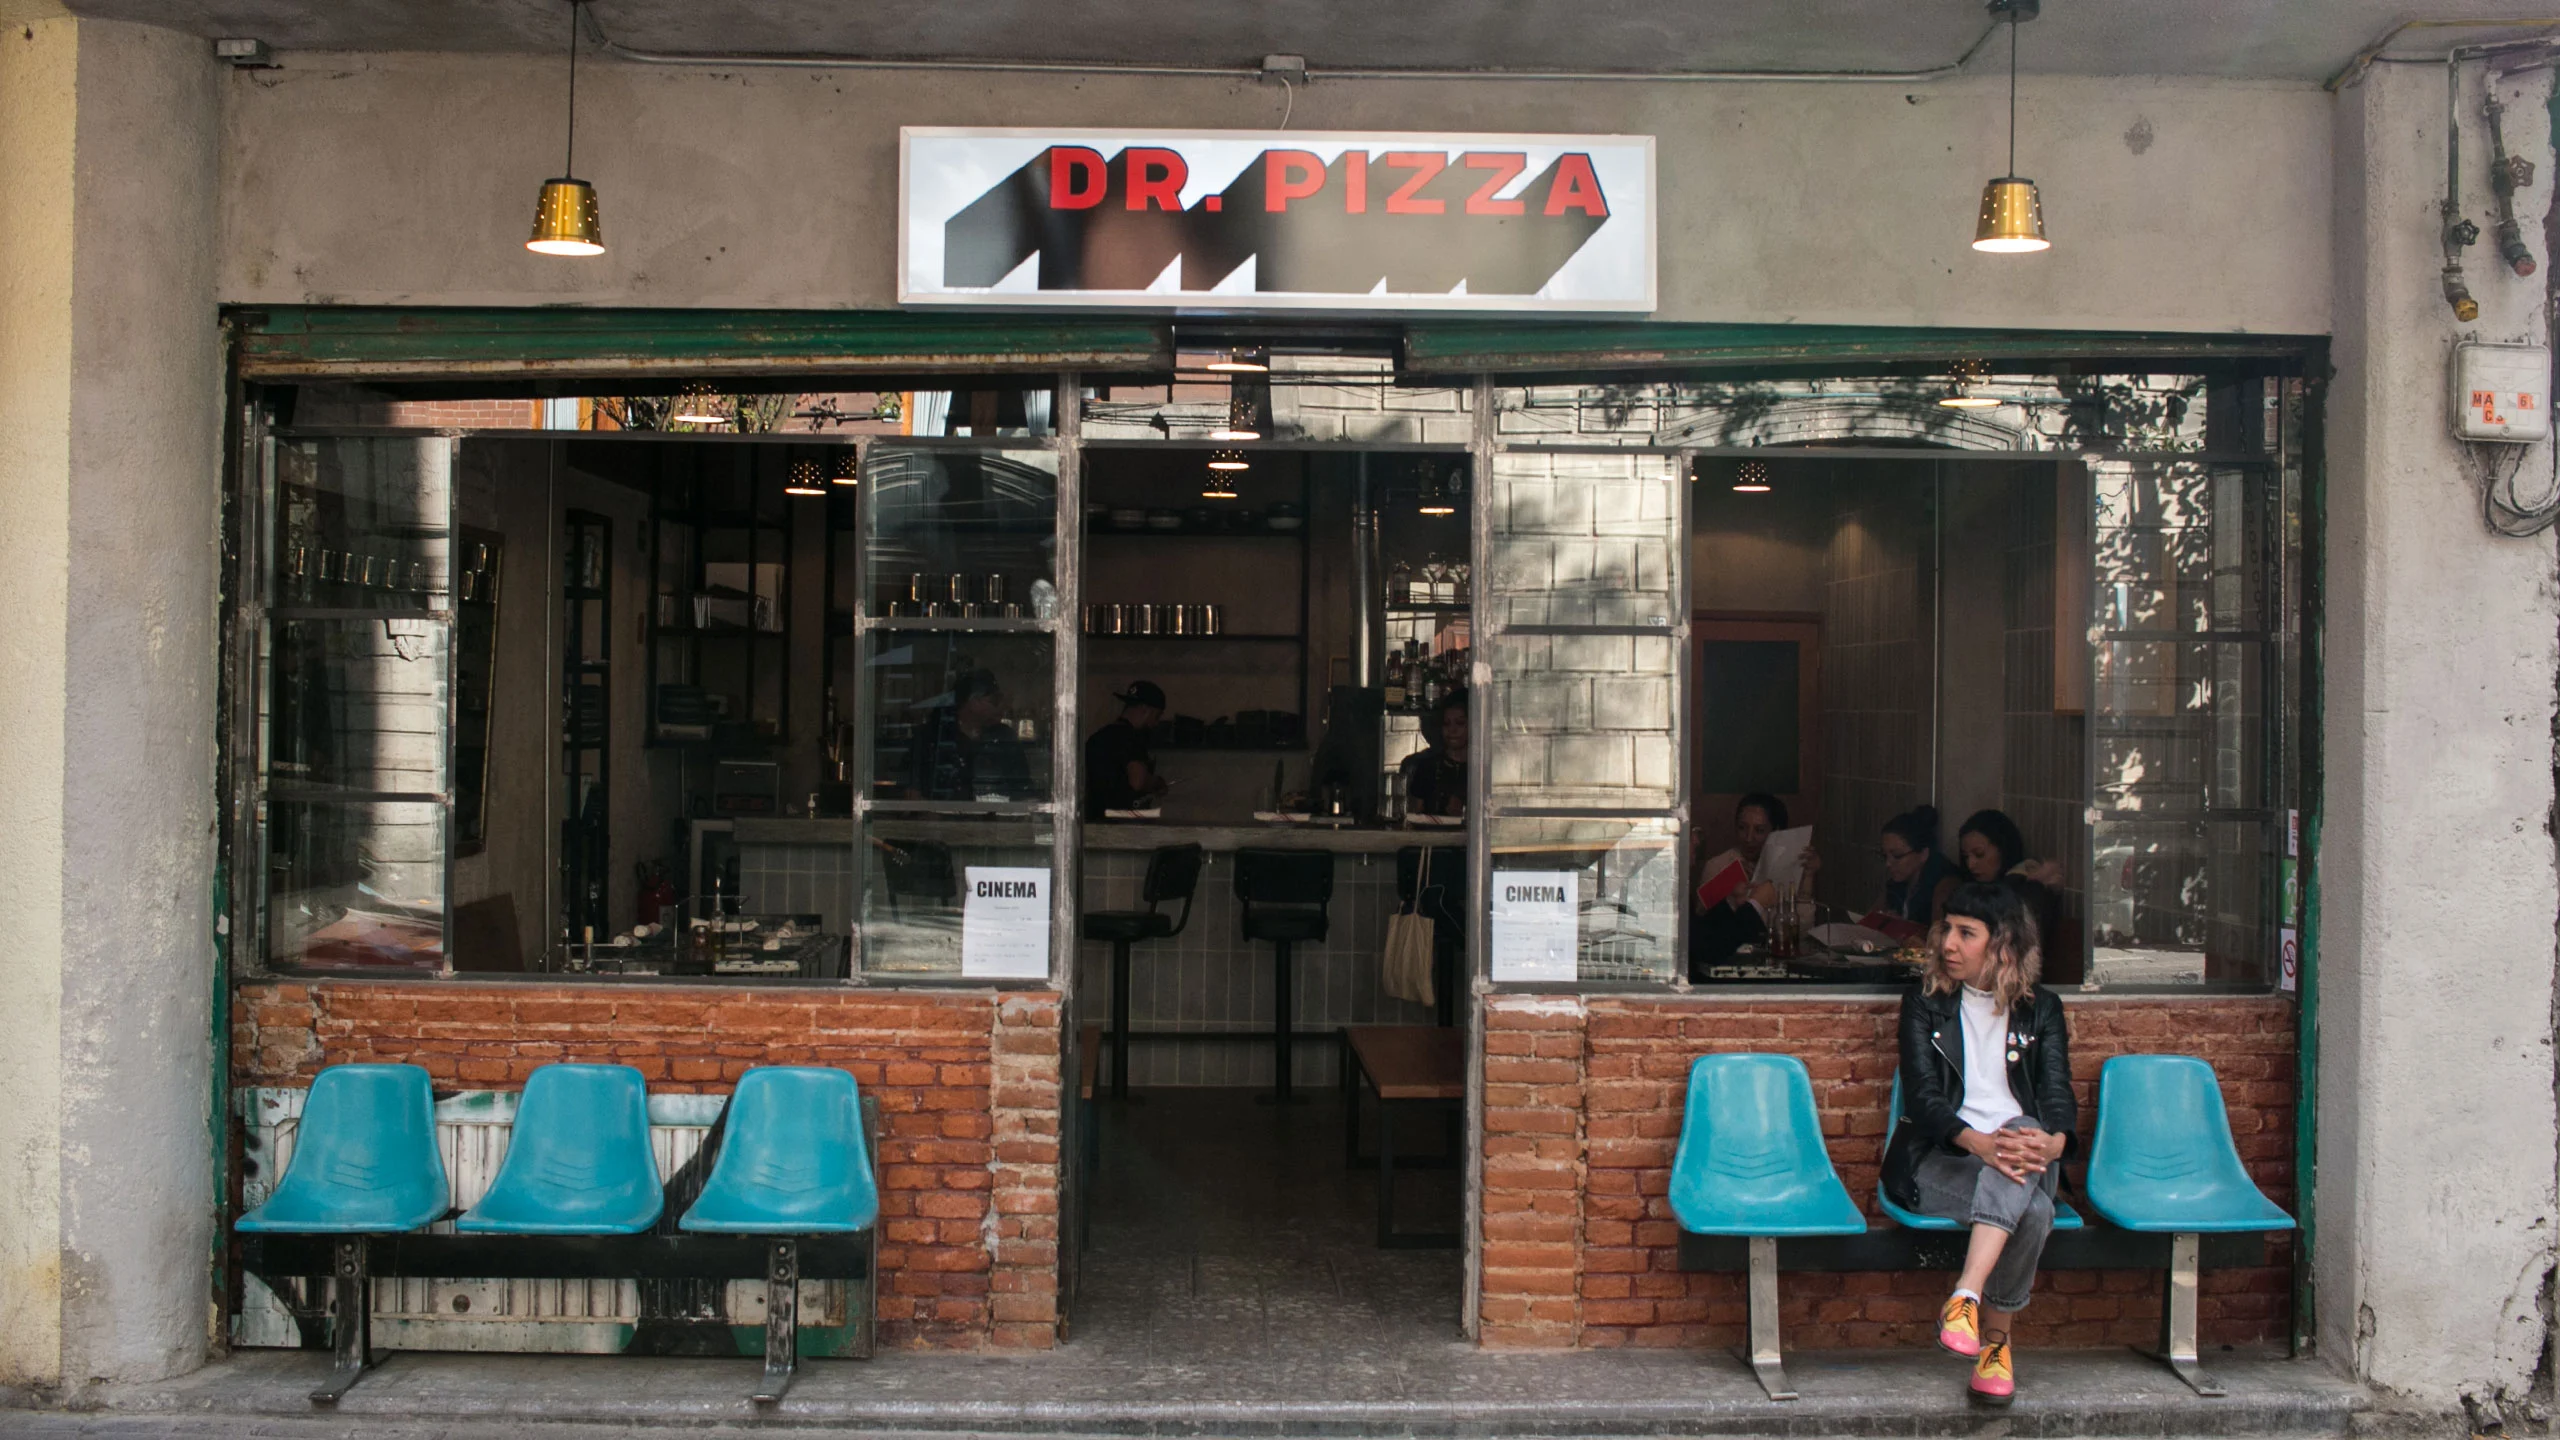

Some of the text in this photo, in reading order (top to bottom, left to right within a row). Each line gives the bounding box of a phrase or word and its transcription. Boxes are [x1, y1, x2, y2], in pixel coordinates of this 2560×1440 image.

[1048, 144, 1610, 217] DR. PIZZA
[976, 881, 1037, 898] CINEMA
[1505, 886, 1566, 902] CINEMA
